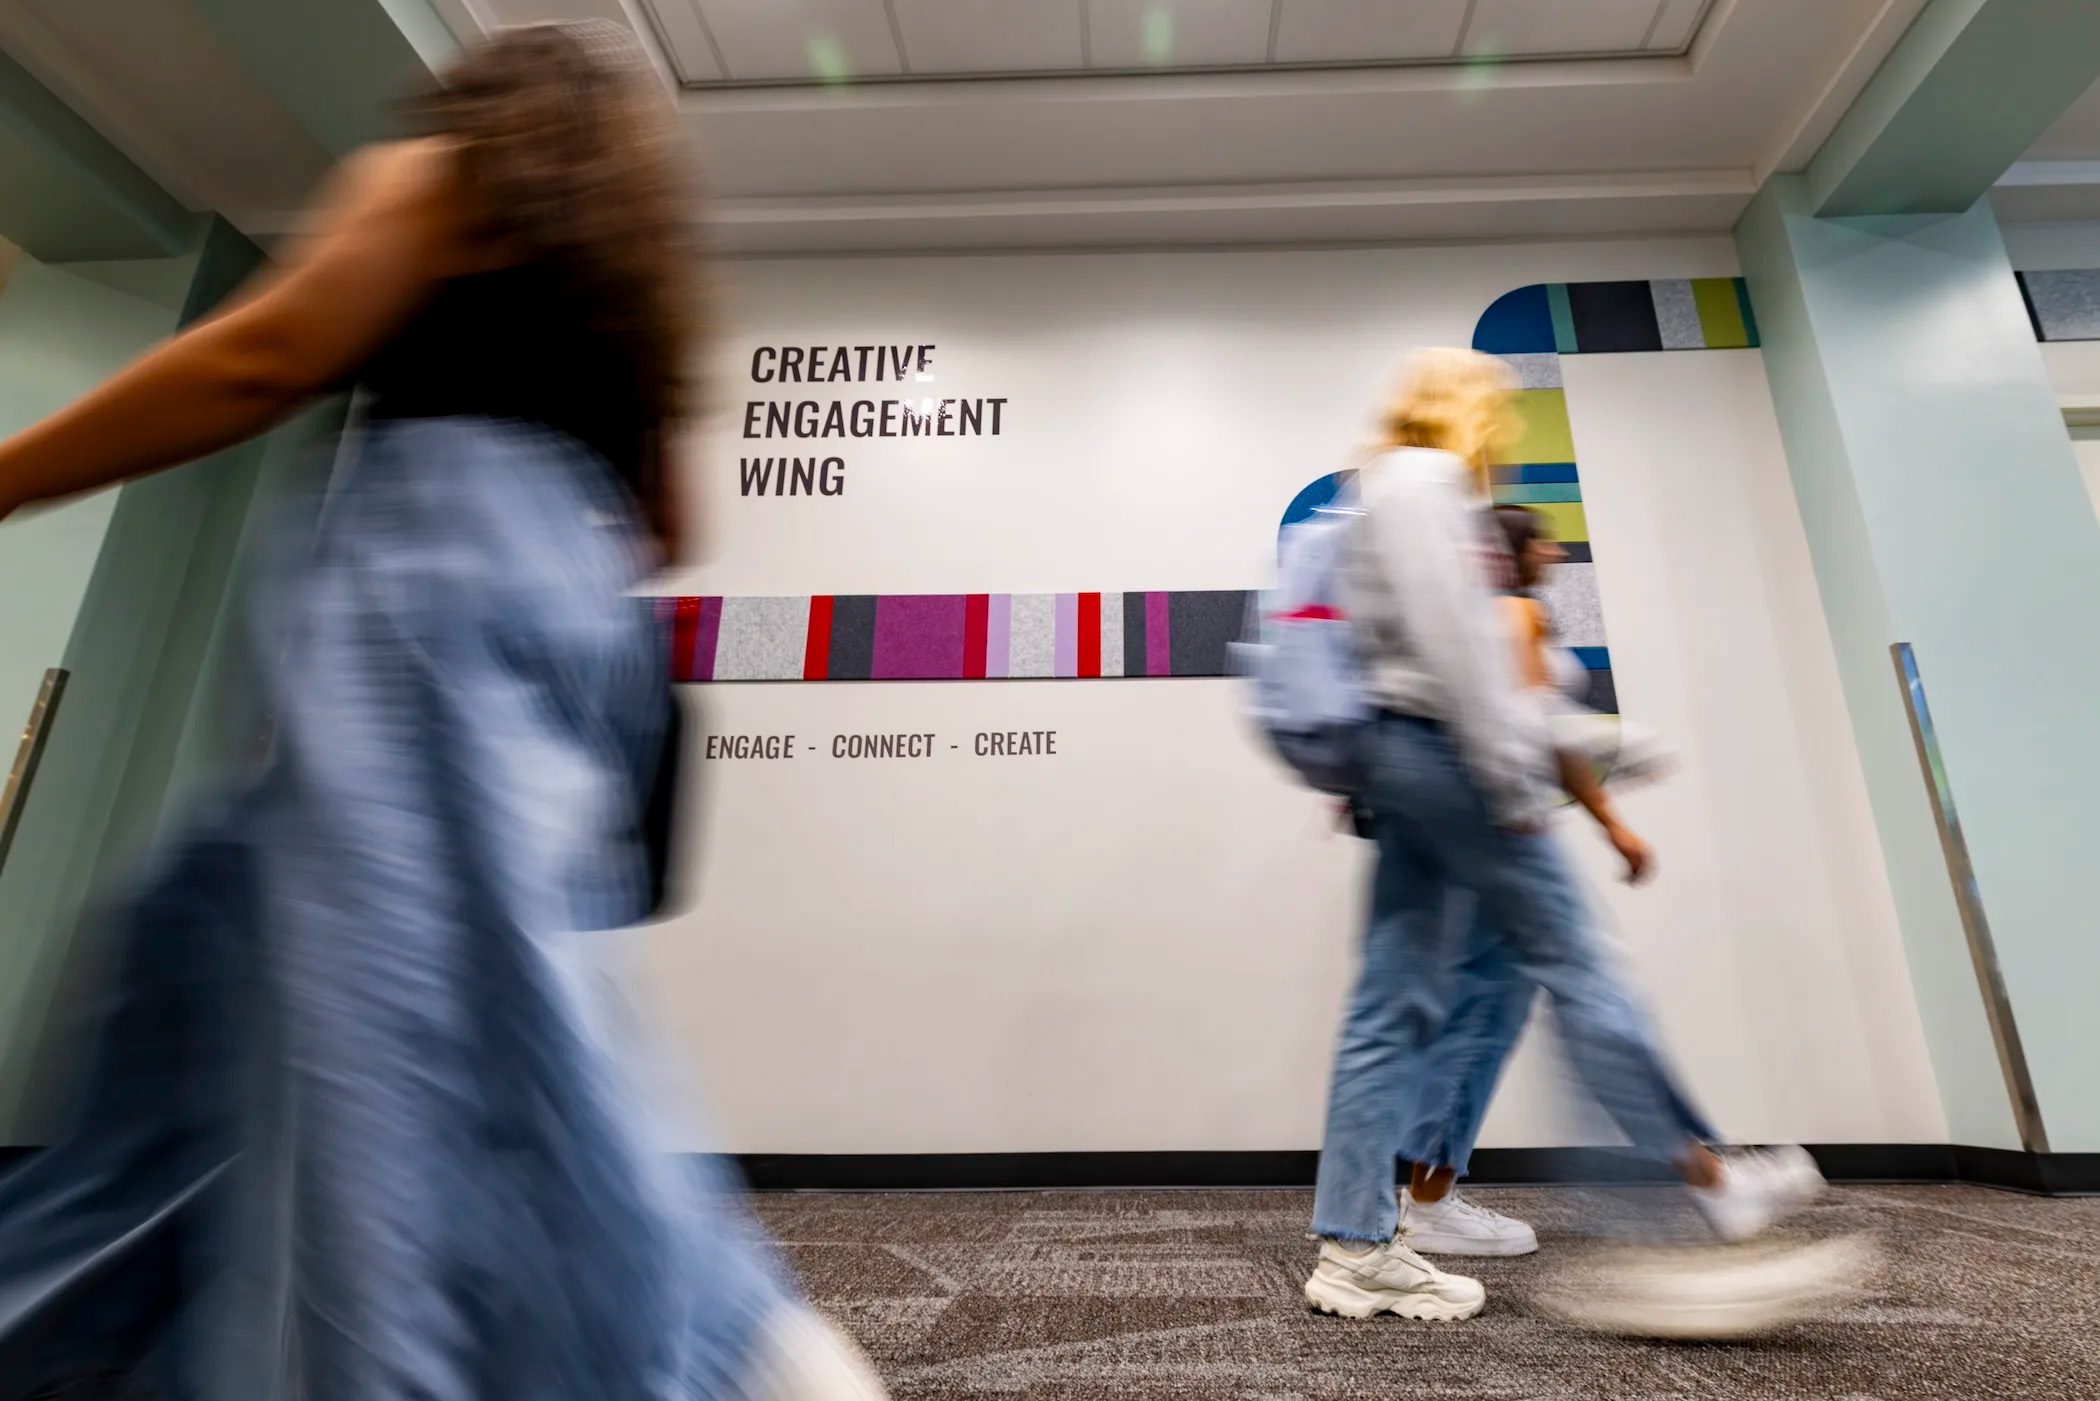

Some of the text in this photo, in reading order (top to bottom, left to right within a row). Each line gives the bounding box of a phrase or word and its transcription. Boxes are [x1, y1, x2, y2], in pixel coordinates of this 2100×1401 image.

[751, 344, 936, 383] CREATIVE
[742, 398, 1008, 439] ENGAGEMENT
[739, 457, 845, 497] WING
[705, 735, 796, 760] ENGAGE
[832, 733, 936, 759] CONNECT
[974, 731, 1057, 757] CREATE
